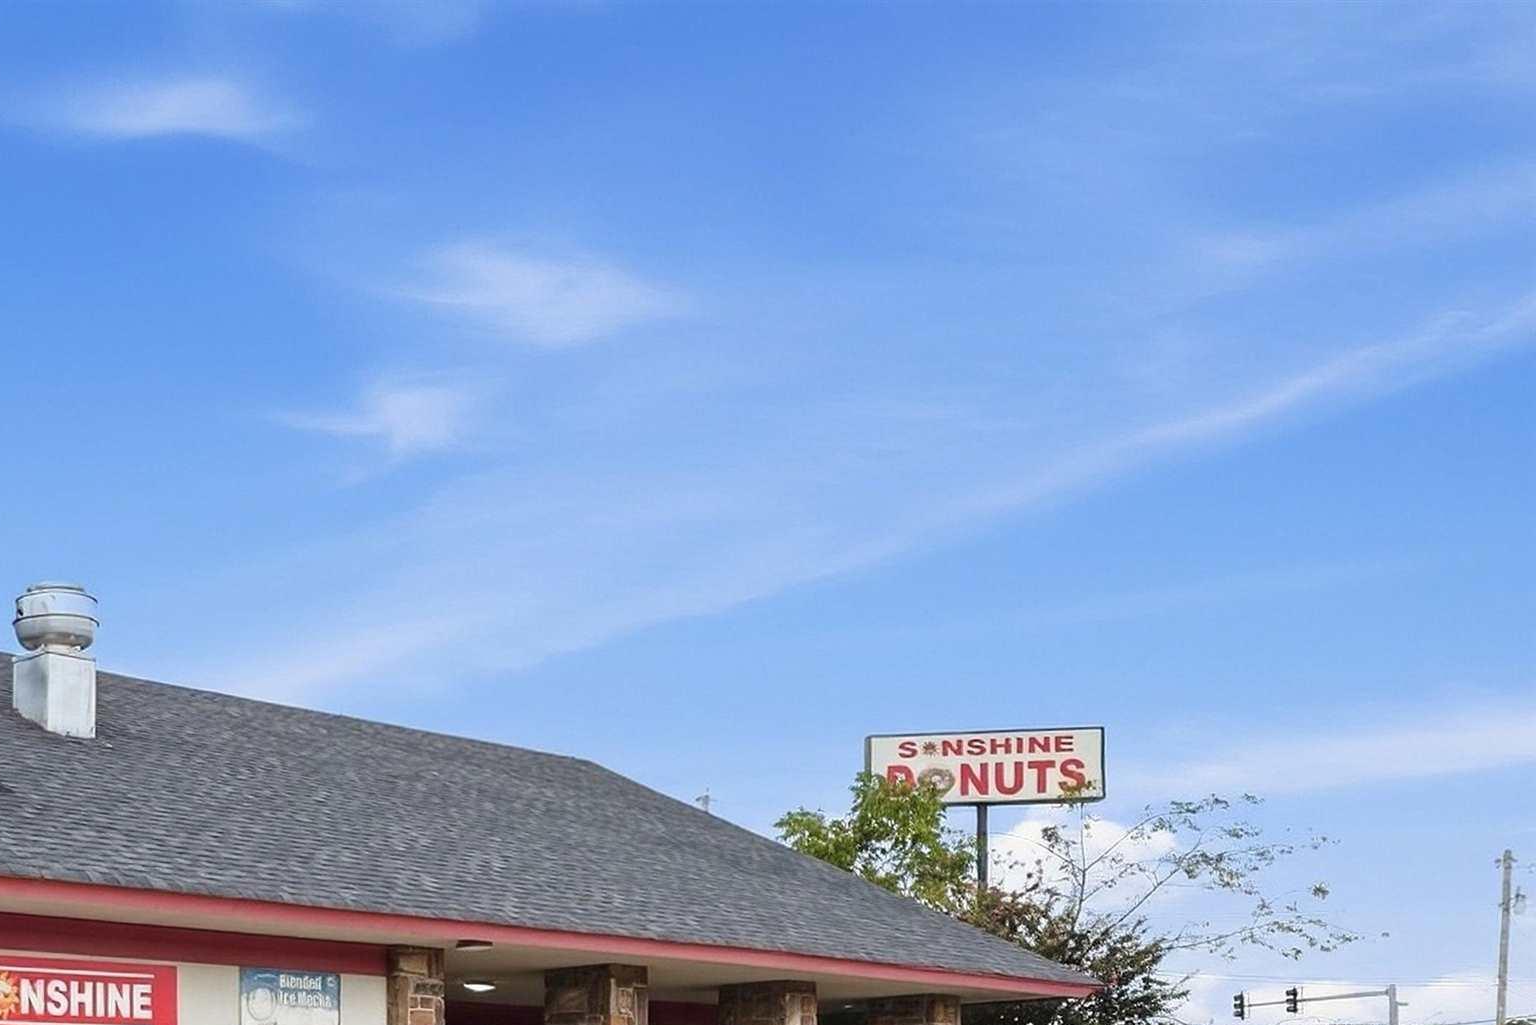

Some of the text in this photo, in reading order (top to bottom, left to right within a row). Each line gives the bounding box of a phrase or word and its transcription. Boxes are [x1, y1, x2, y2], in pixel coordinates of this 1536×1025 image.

[898, 735, 1075, 759] SNSHINE
[885, 758, 1087, 797] DONUTS
[279, 973, 322, 991] Blended
